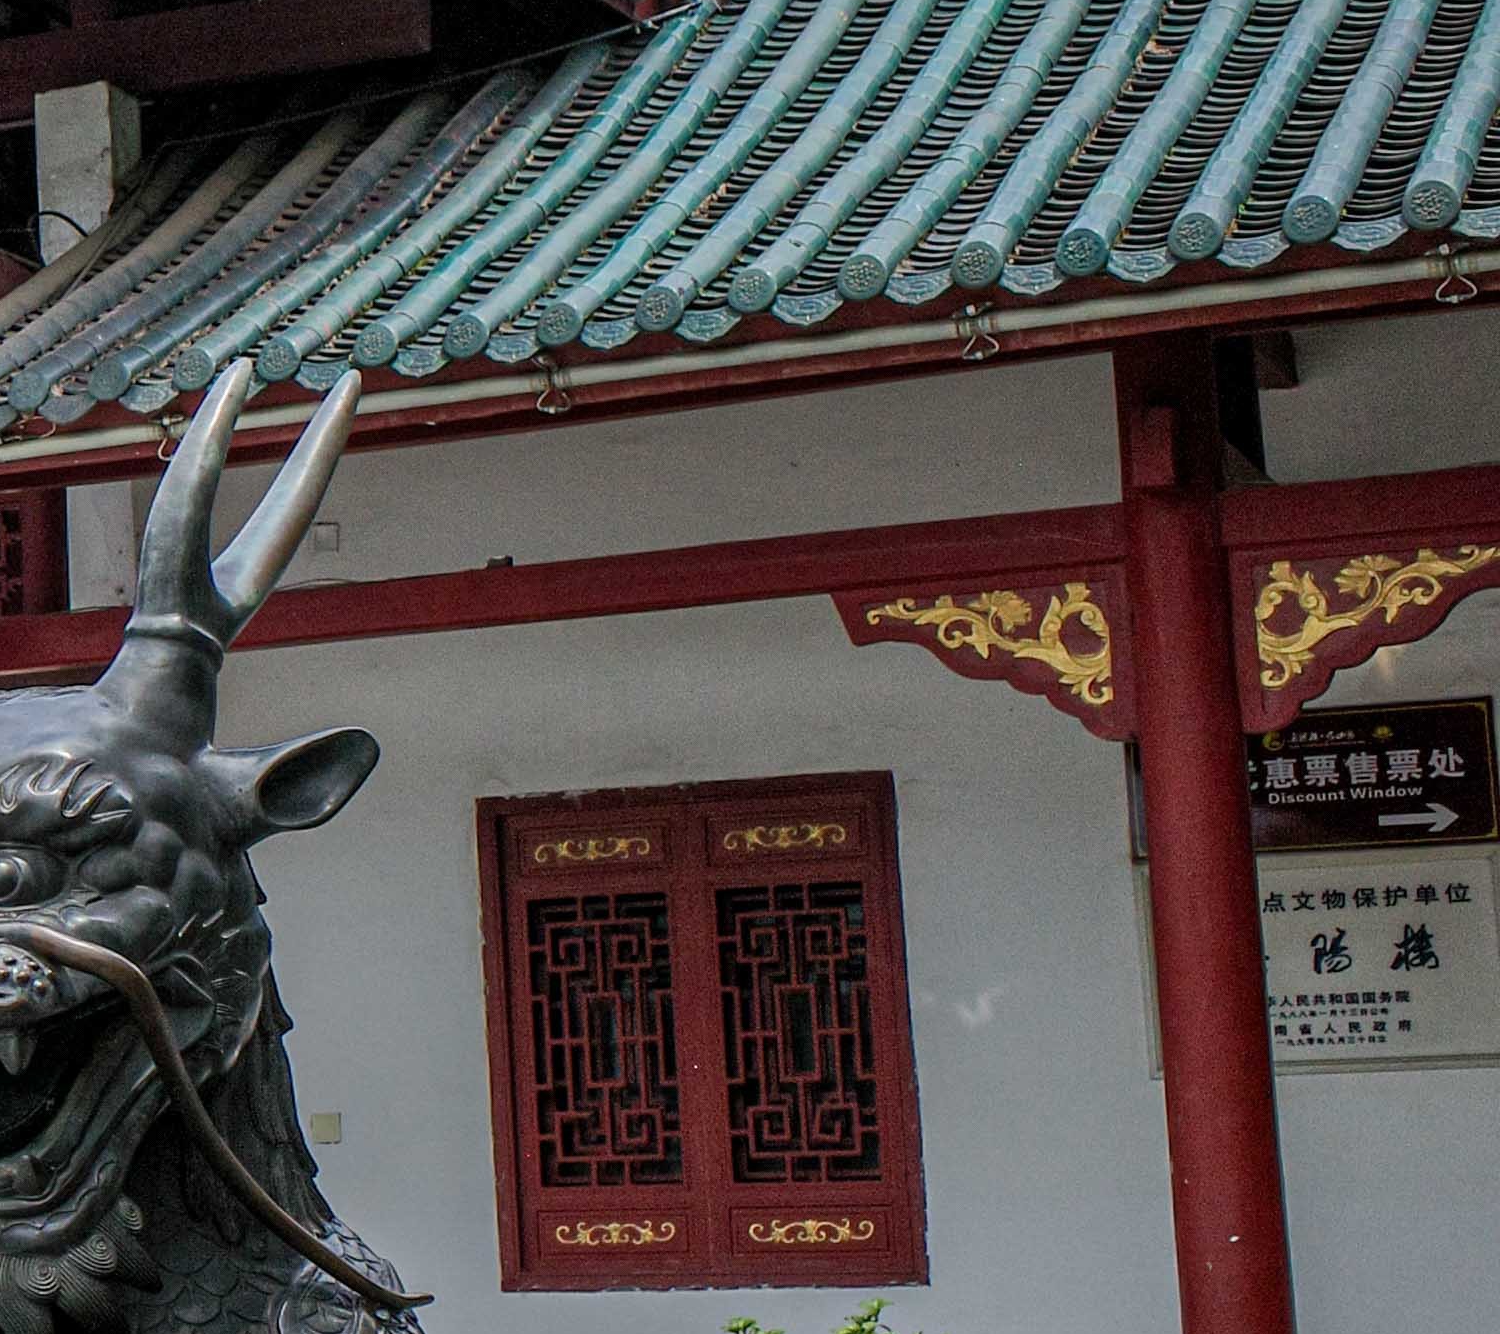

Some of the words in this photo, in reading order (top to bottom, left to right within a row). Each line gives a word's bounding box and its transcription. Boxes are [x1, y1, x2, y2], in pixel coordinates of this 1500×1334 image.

[1268, 790, 1346, 805] Discount
[1351, 784, 1423, 800] Window
[1262, 883, 1472, 913] 点文物保护单位
